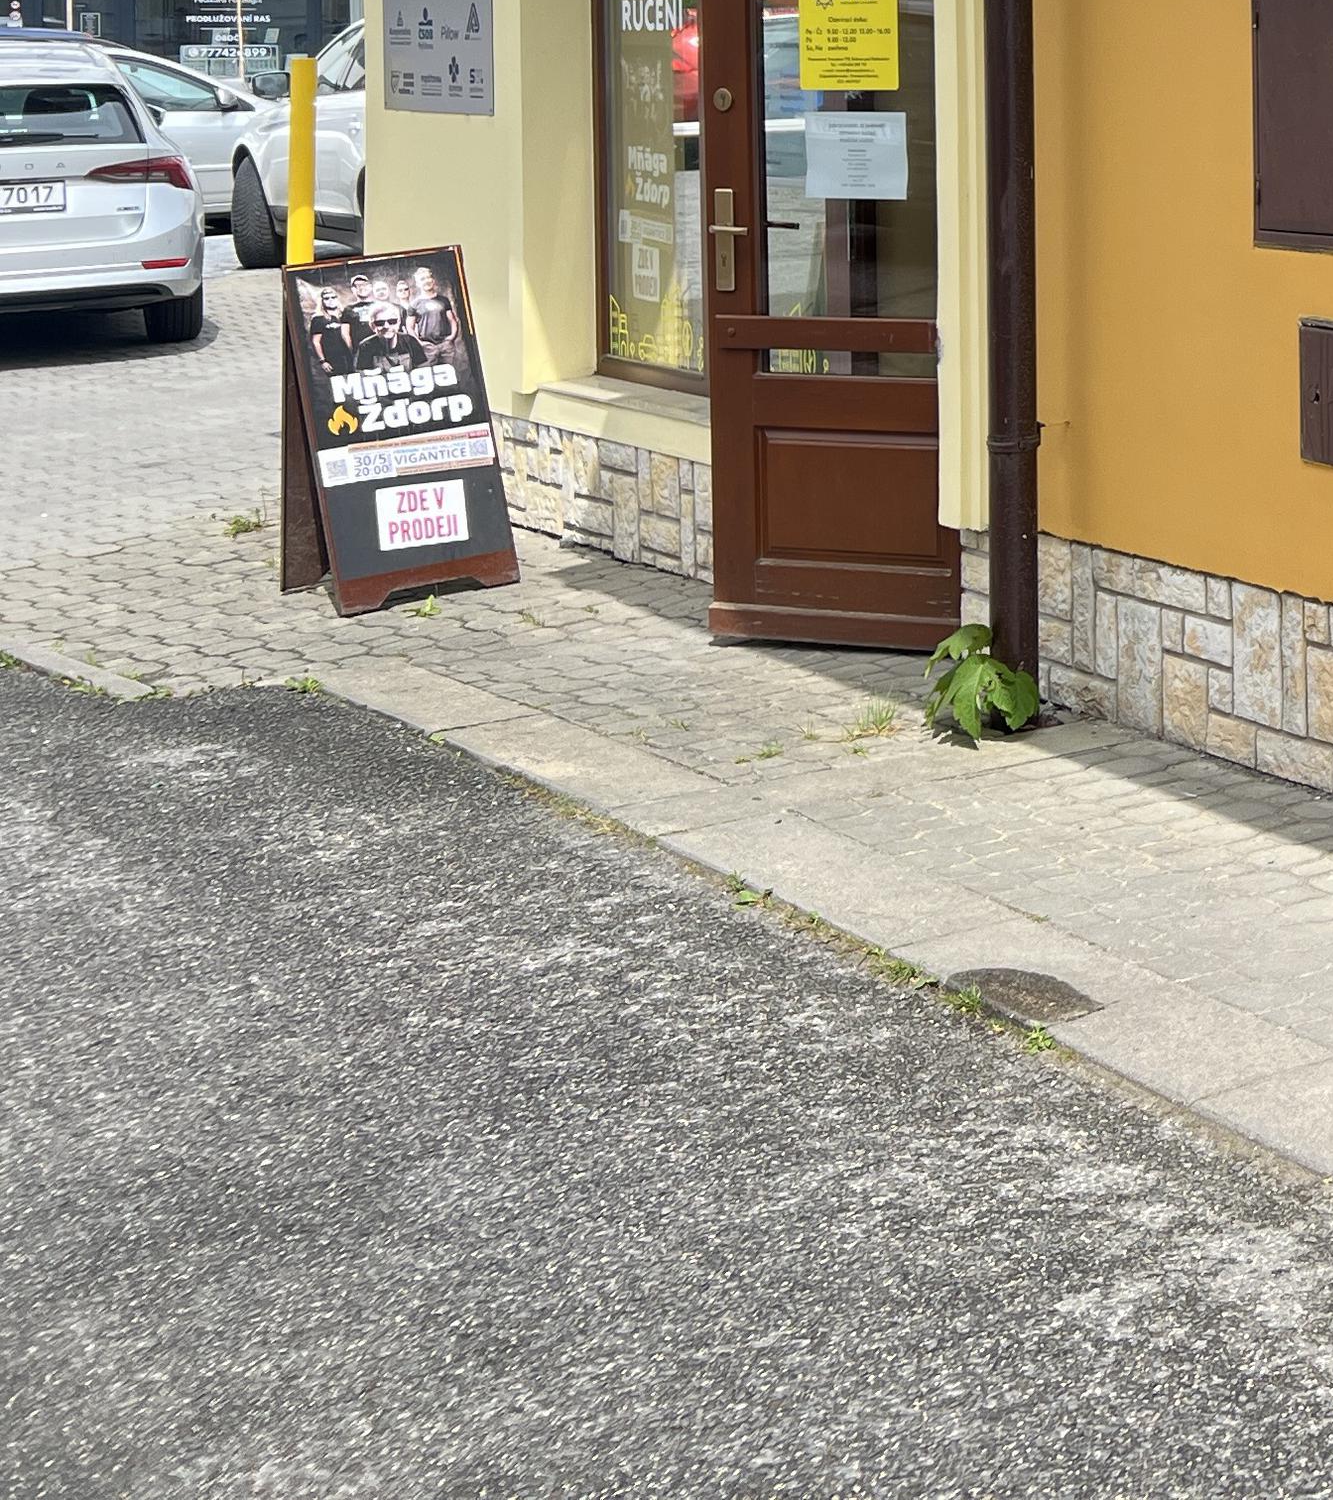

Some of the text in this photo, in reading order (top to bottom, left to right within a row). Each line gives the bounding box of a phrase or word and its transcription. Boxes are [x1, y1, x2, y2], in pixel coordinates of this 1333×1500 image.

[3, 186, 53, 205] 7017
[354, 446, 468, 468] 30/5 VIGANTICE
[396, 487, 444, 514] ZDE V
[388, 514, 458, 544] PRODEJI
